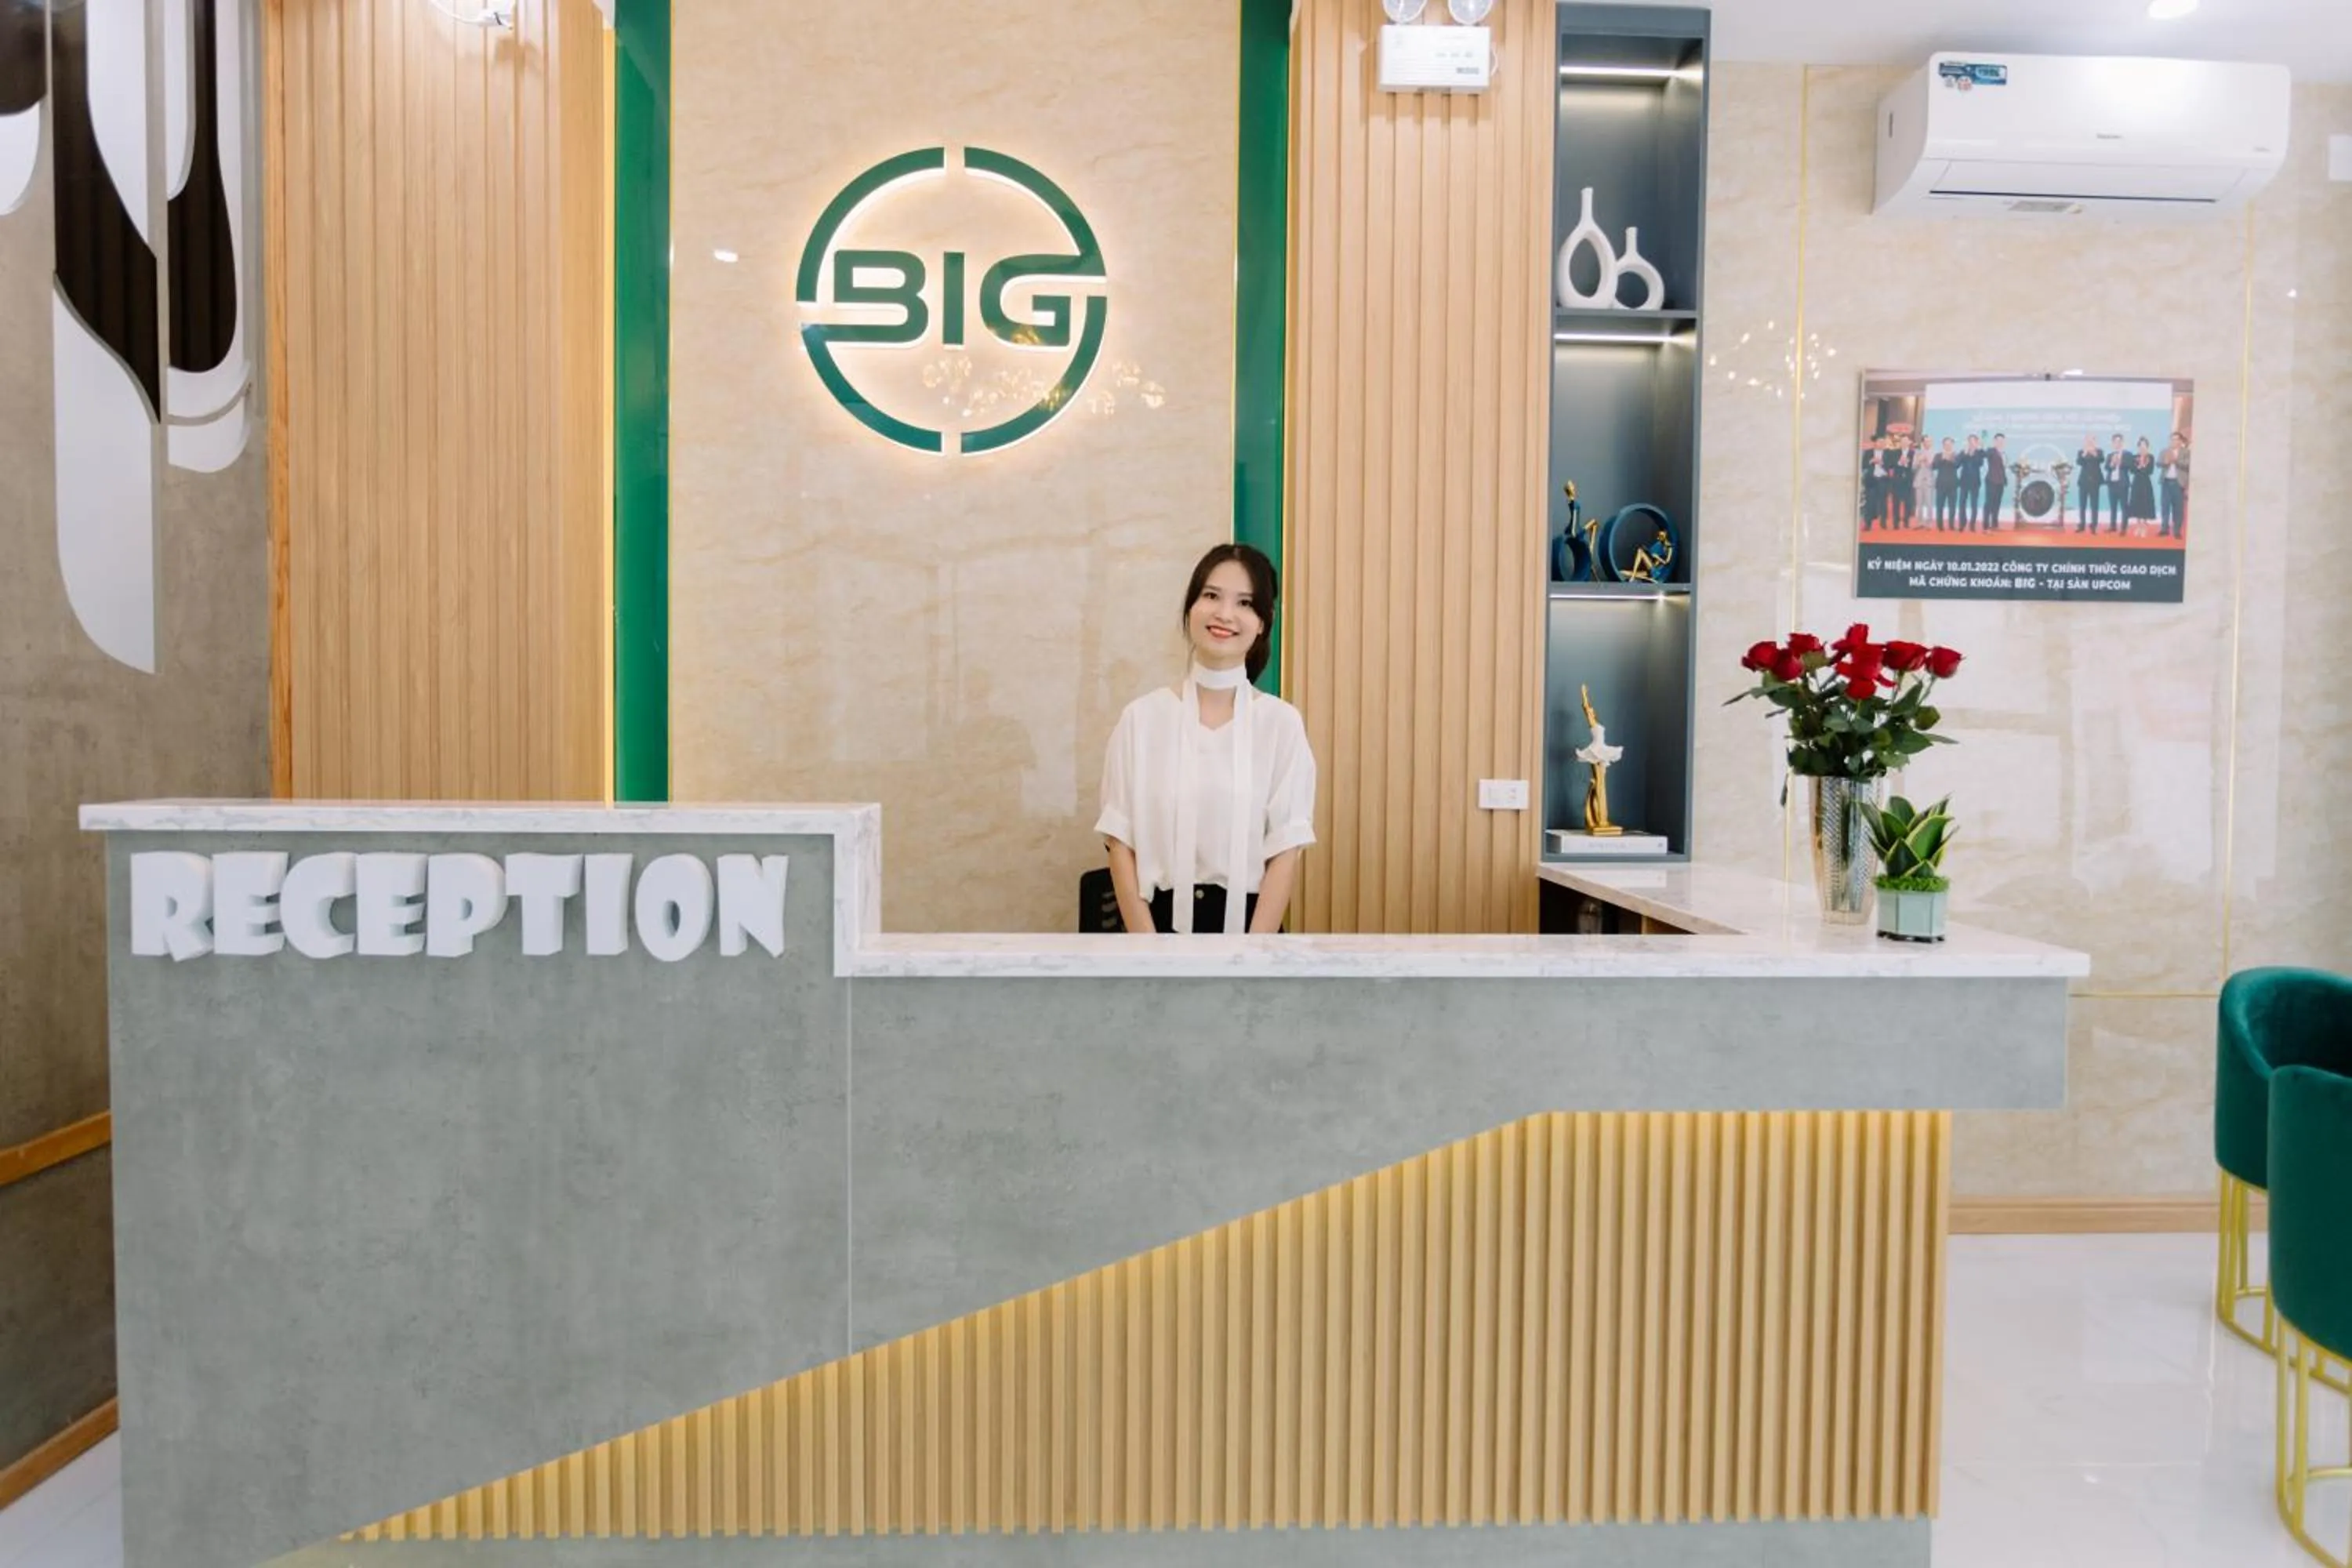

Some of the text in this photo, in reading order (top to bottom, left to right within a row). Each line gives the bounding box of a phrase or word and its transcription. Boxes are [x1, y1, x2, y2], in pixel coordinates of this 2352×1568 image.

[801, 249, 1106, 347] BIG
[1884, 558, 1911, 572] NIỆM
[1914, 559, 1944, 572] NGÀY
[1947, 561, 1999, 572] 10.01.2022
[2002, 560, 2033, 572] CÔNG
[2036, 563, 2049, 572] TY
[2051, 561, 2085, 574] CHÍNH
[2088, 561, 2118, 575] THỨC
[2119, 564, 2147, 575] GIAO
[2149, 564, 2177, 577] DỊCH
[1909, 575, 1926, 586] MÃ
[1928, 575, 1967, 587] CHỨNG
[2014, 578, 2036, 589] BIG
[2047, 579, 2064, 591] TẠI
[2091, 580, 2131, 590] UPCOM
[130, 851, 789, 962] RECEPTION
